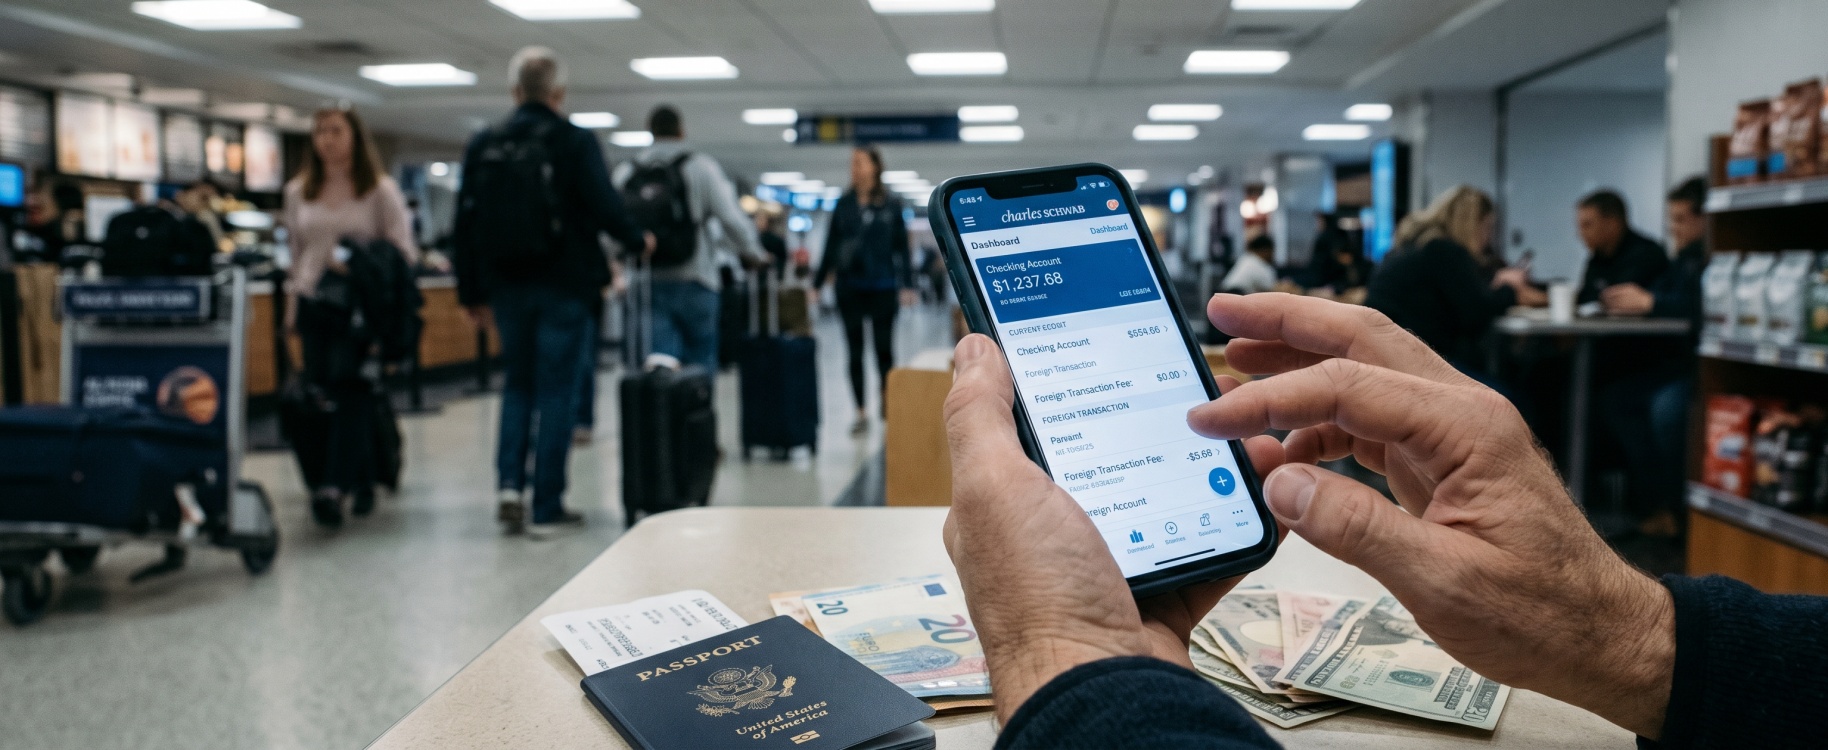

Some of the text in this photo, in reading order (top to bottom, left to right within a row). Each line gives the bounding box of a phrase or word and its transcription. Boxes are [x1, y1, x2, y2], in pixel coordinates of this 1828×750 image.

[1001, 205, 1086, 223] charles SCHWAB
[1090, 223, 1129, 235] Dashboard
[971, 236, 1020, 250] Dashboard
[986, 257, 1062, 274] Checking Account
[992, 272, 1063, 294] $1,237.68
[1016, 338, 1090, 356] Checking Account
[1025, 359, 1097, 378] Foreign Transaction
[1156, 371, 1180, 382] $0.00
[1034, 379, 1133, 404] Foreign Transaction Fee:
[1042, 402, 1130, 424] FOREIGN TRANSACTION
[1064, 455, 1165, 482] Foreign Transaction Fee:
[1085, 497, 1147, 518] oreign Account
[816, 600, 848, 616] 20
[918, 614, 976, 644] 20
[636, 635, 762, 682] PASSPORT
[735, 700, 828, 735] United States
[752, 710, 829, 740] of America
